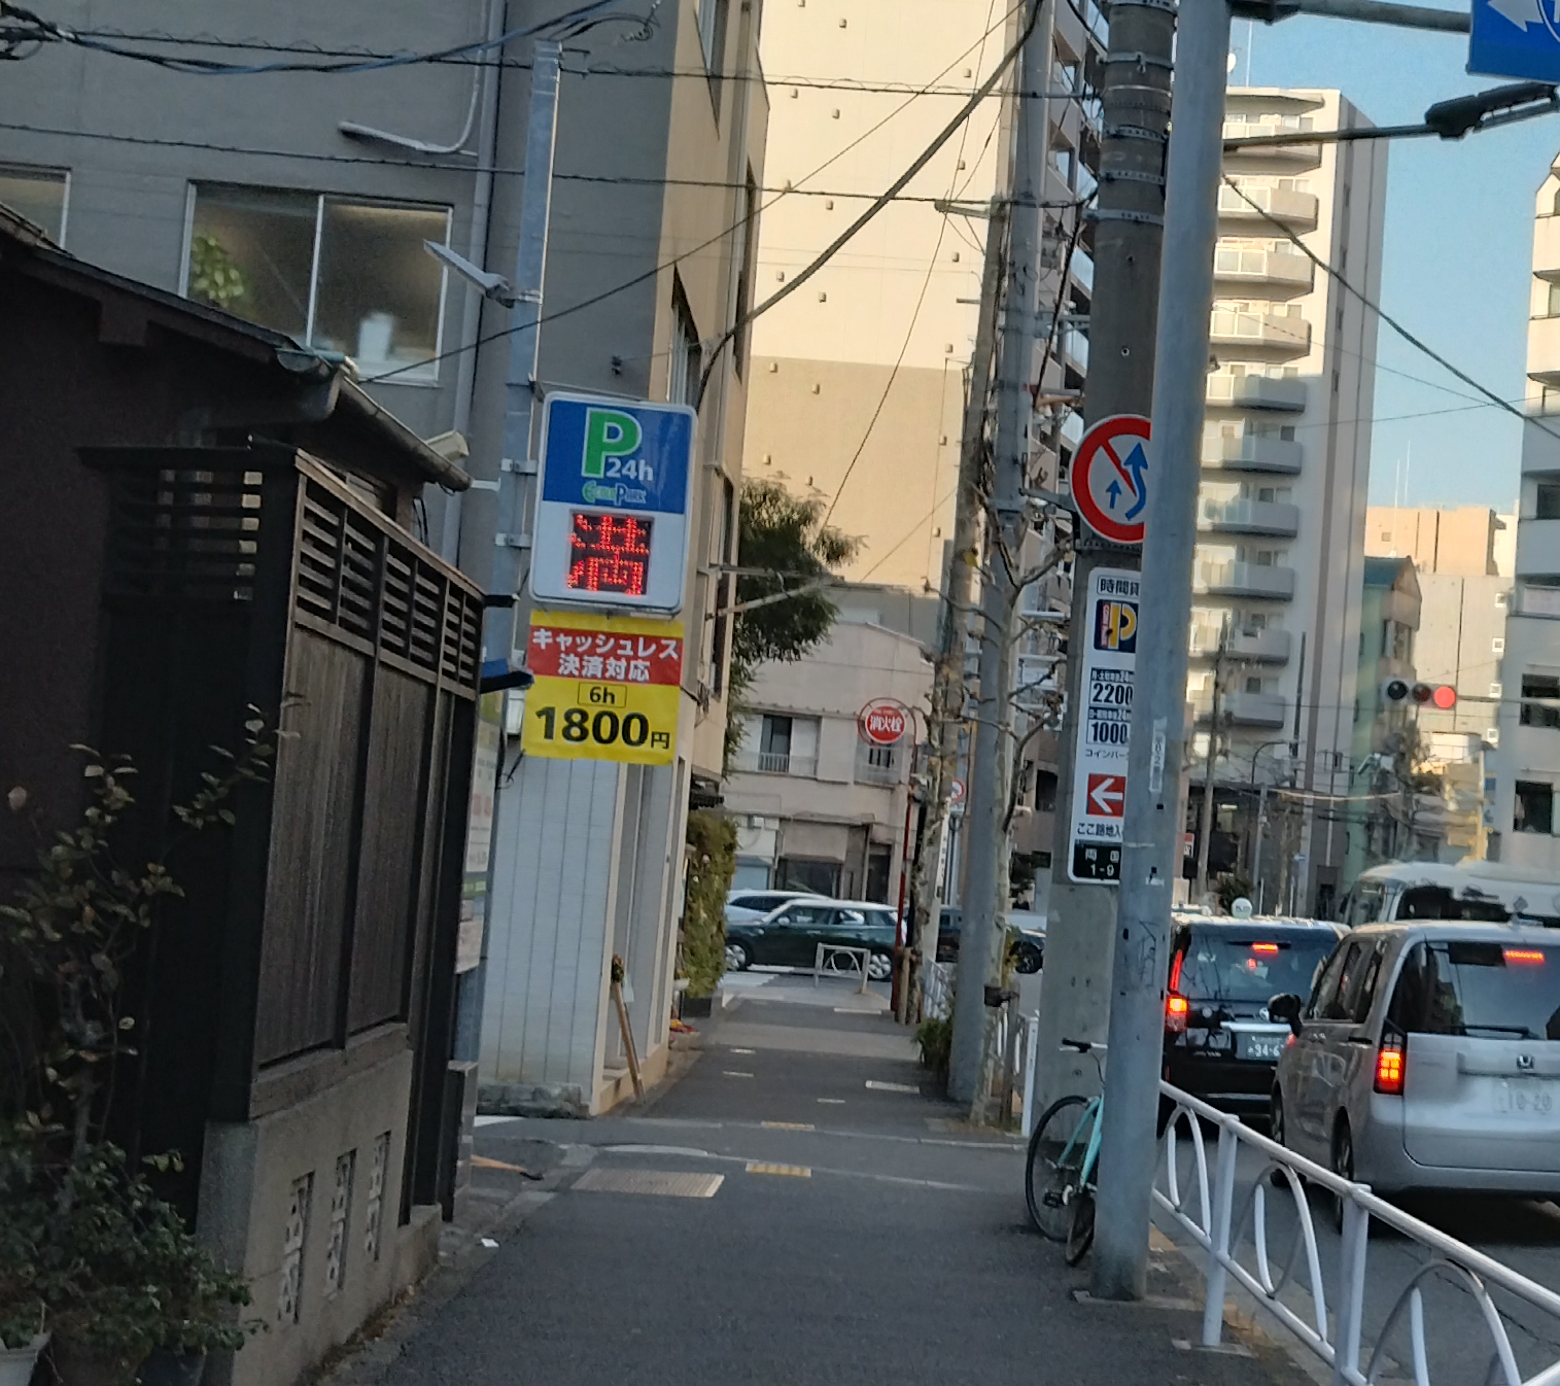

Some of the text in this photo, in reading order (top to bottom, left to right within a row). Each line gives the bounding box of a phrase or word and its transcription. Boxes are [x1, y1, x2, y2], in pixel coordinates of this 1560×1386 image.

[581, 407, 642, 478] P
[606, 457, 654, 481] 24h
[532, 628, 679, 660] キャッシュレス
[557, 654, 650, 682] 決済対応
[589, 686, 616, 705] 6h
